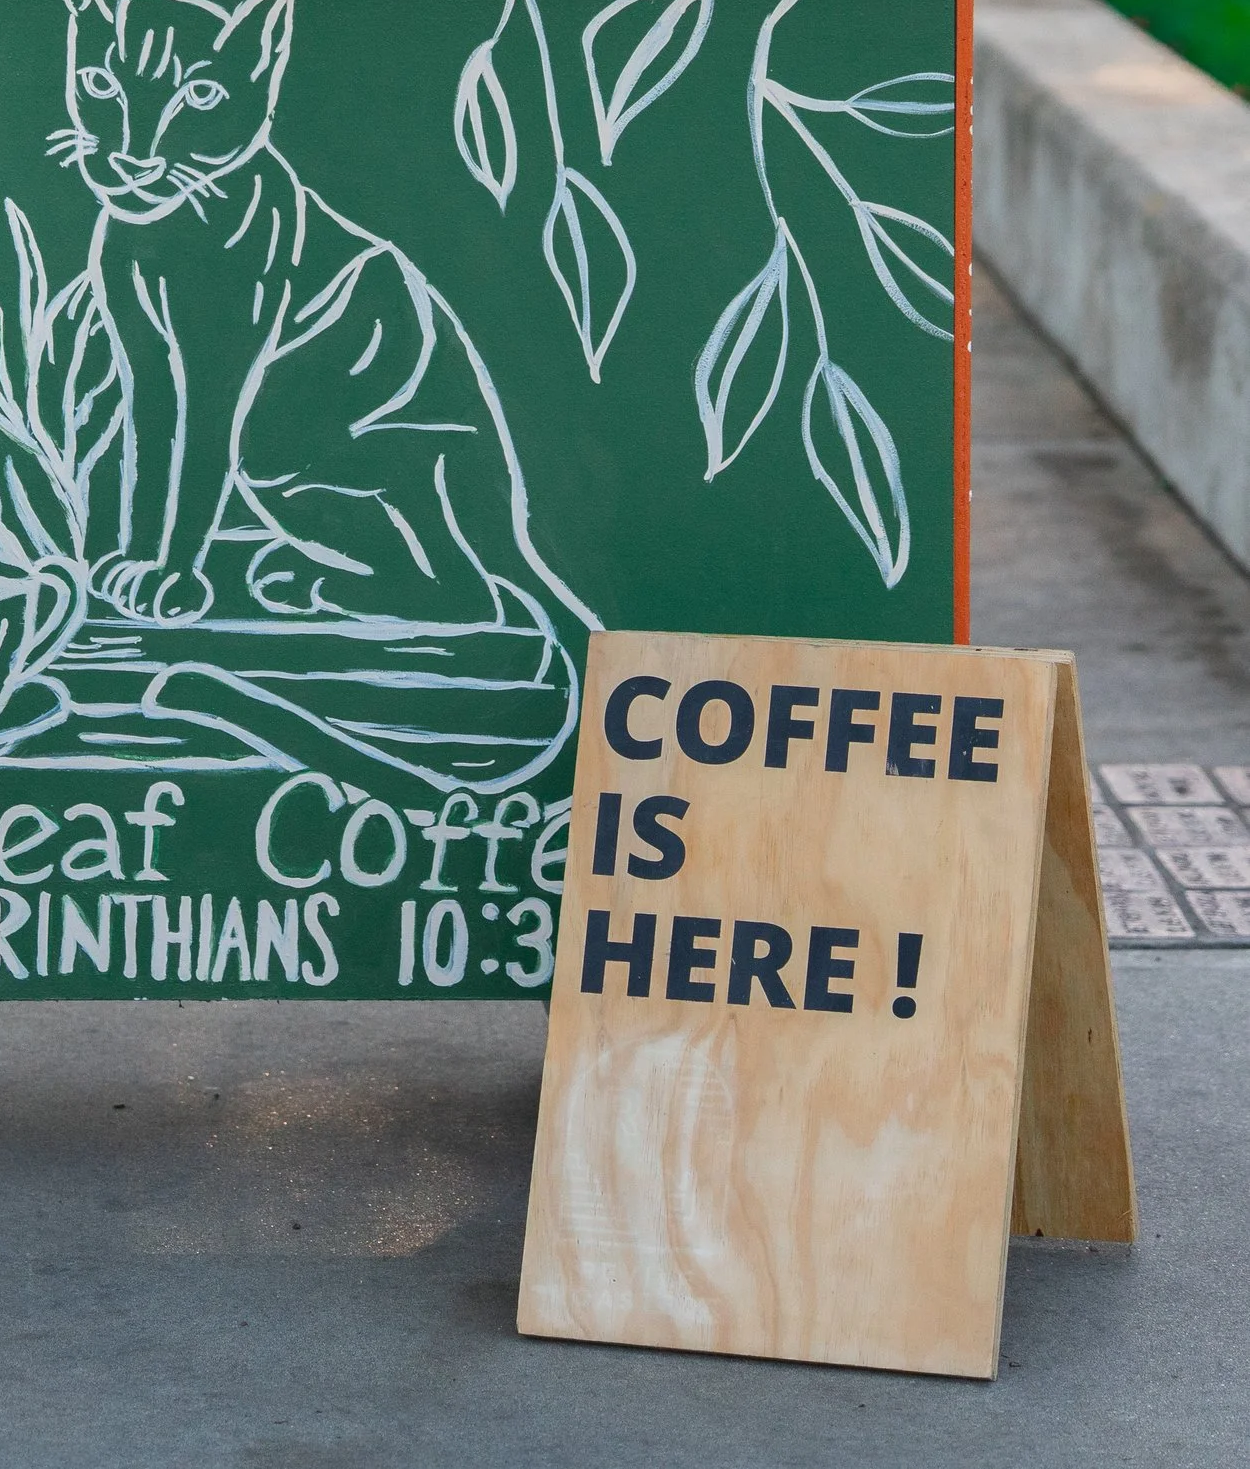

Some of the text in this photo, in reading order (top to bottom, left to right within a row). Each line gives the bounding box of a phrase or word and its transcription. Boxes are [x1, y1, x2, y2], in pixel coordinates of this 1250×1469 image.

[604, 675, 1005, 782] COFFEE
[591, 792, 691, 881] IS
[580, 910, 860, 1014] HERE
